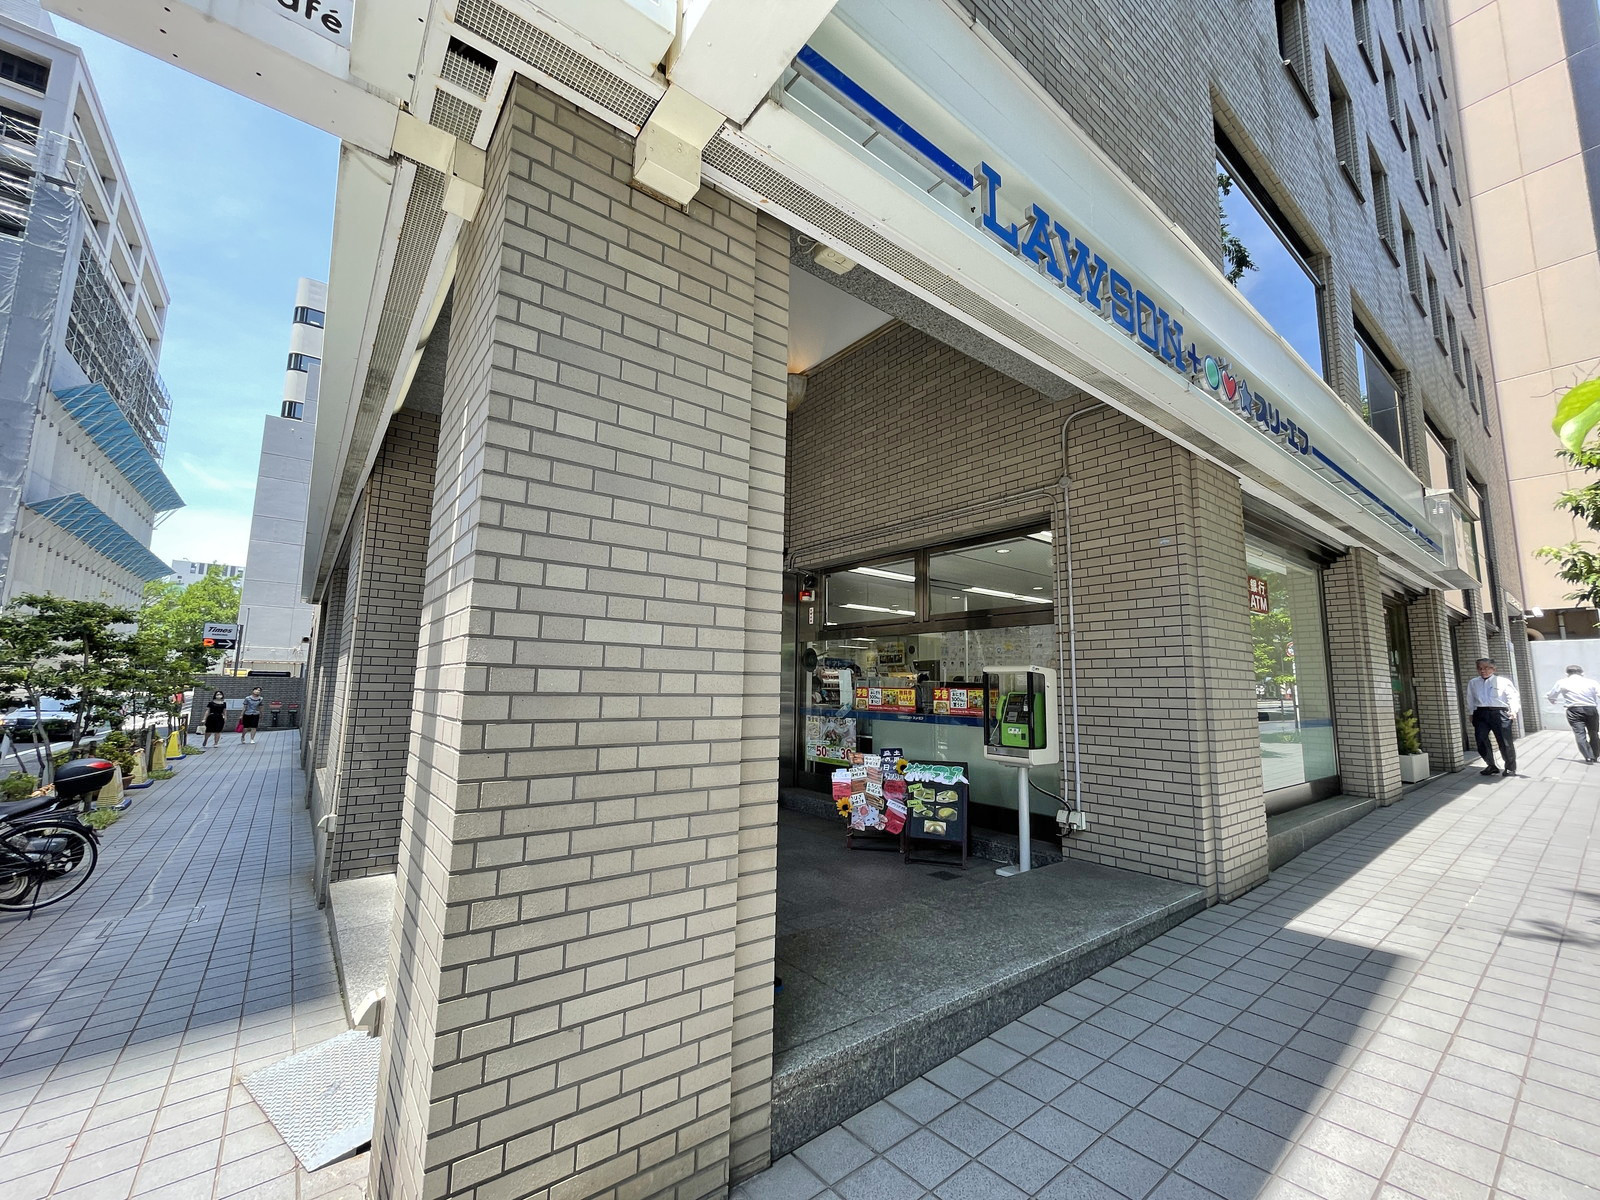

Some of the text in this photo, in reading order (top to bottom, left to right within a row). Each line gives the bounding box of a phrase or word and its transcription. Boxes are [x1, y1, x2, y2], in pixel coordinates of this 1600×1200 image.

[981, 160, 1187, 373] LAWSON
[1253, 391, 1309, 456] スリーエフ
[1250, 578, 1265, 595] 銀行
[1250, 594, 1268, 611] ATM
[856, 688, 868, 697] 予告
[934, 689, 949, 699] 予告
